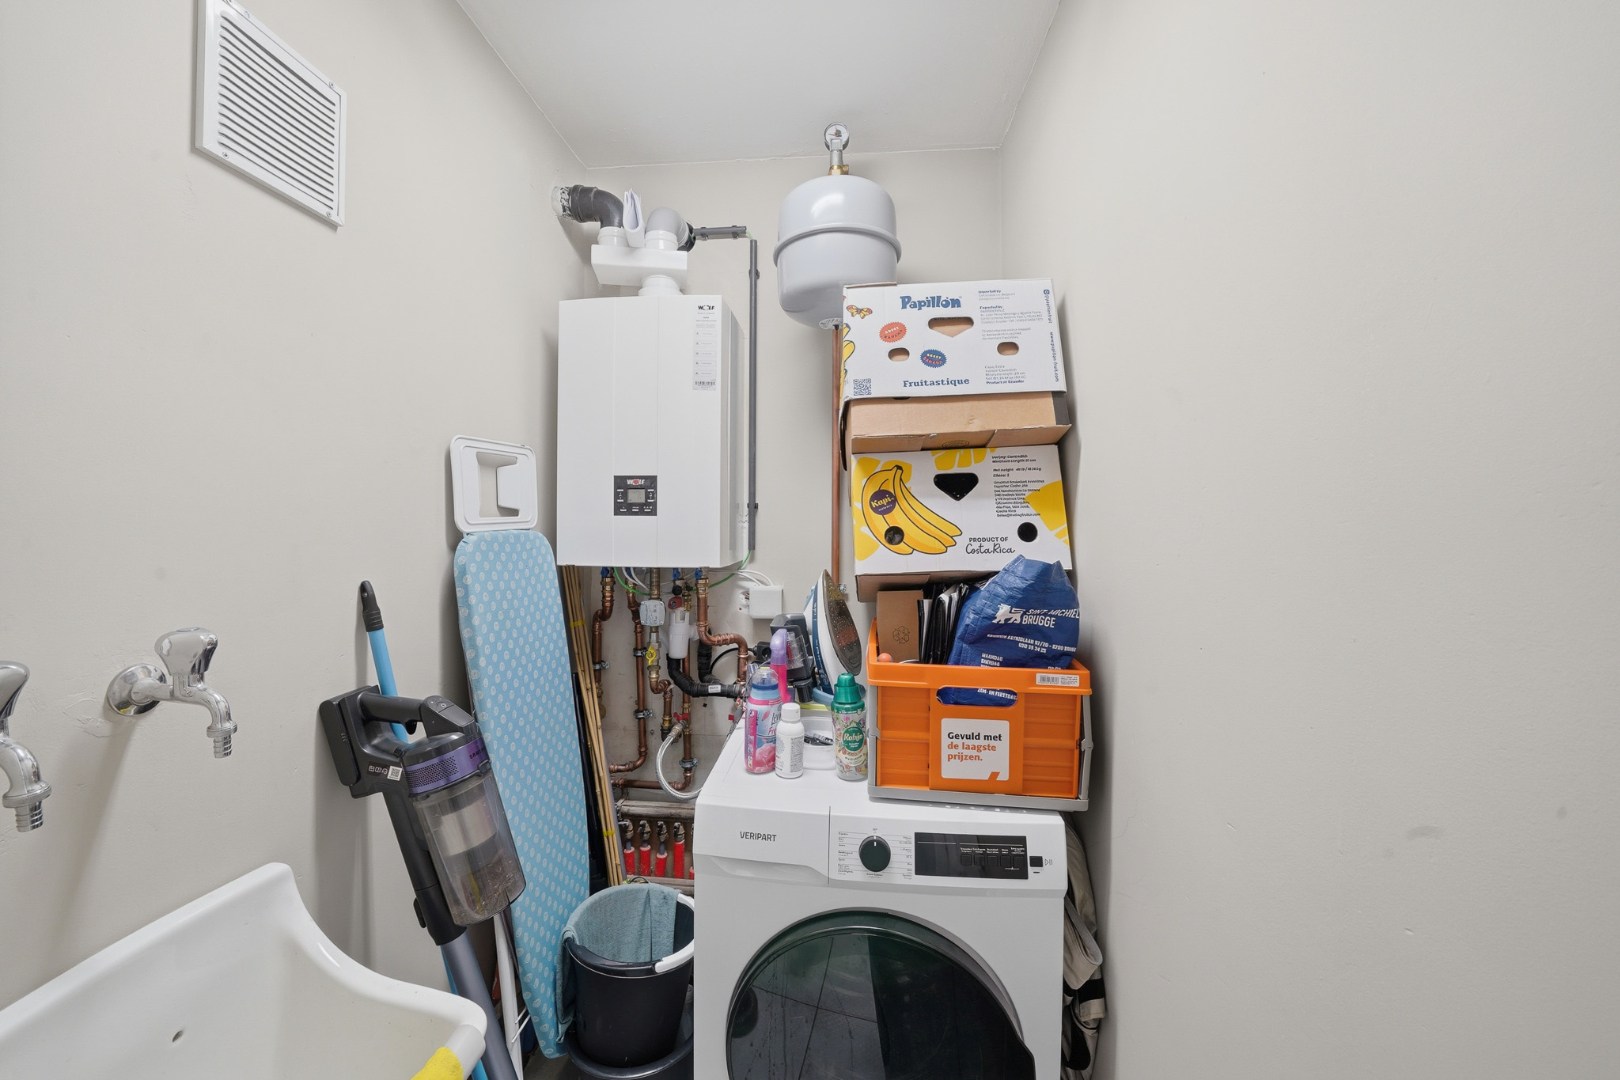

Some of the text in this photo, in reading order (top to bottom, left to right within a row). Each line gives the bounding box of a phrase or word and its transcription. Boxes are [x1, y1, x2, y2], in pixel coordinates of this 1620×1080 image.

[903, 377, 970, 388] Fruitastique
[965, 542, 1016, 555] Costa Rica
[1022, 614, 1056, 628] BRUGGE
[947, 731, 1003, 742] Gevuld met
[947, 741, 997, 753] de laagste
[947, 752, 983, 763] prijzen.
[739, 831, 777, 843] VERIPART
